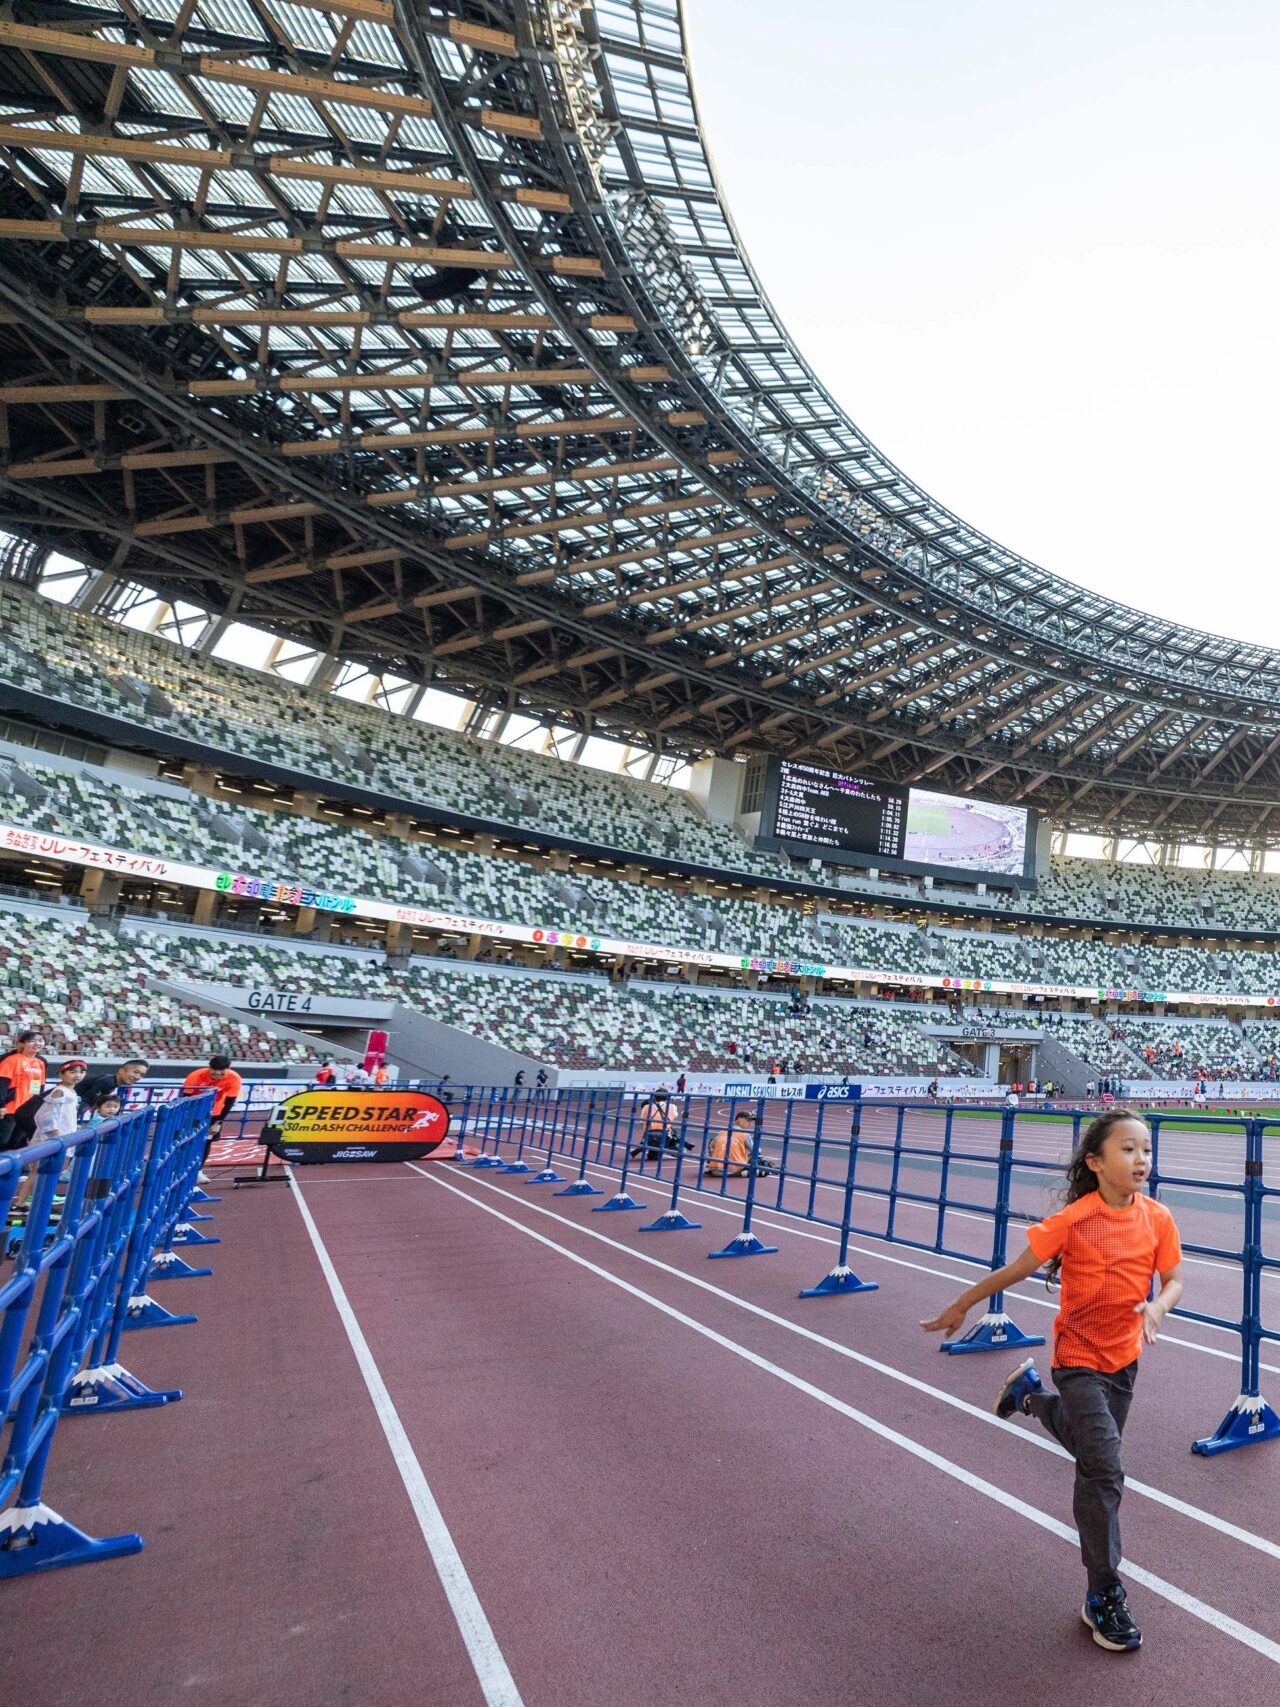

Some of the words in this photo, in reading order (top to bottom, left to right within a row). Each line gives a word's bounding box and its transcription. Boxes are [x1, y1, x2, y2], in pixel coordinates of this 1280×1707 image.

[6, 830, 39, 841] みんなで
[39, 838, 168, 875] リレーフェスティバル
[417, 914, 504, 934] リレーフェスティバル
[248, 991, 299, 1011] GATE
[301, 996, 312, 1012] 4
[962, 1027, 988, 1037] GATE
[780, 1087, 803, 1097] セレスポ
[287, 1105, 360, 1121] SPEED
[361, 1106, 418, 1122] STAR
[310, 1123, 345, 1132] DASH
[346, 1123, 412, 1133] CHALLENGE
